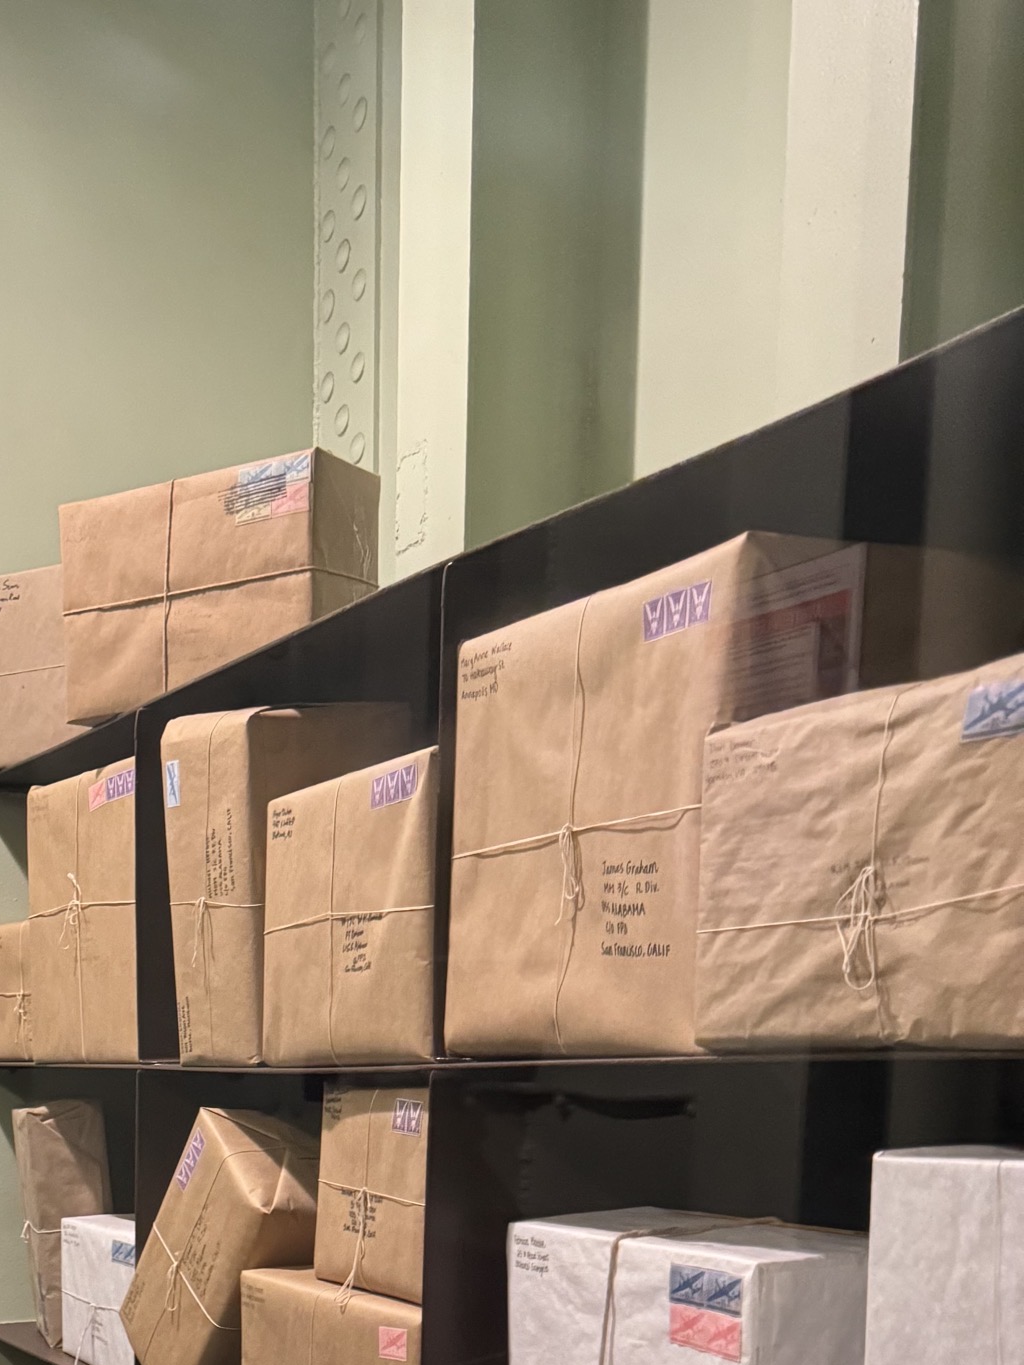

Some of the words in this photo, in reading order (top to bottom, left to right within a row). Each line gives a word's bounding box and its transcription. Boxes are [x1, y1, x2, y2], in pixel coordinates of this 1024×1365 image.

[602, 860, 624, 876] James
[626, 859, 659, 876] Graham
[611, 902, 646, 918] ALABAMA
[601, 941, 614, 956] San
